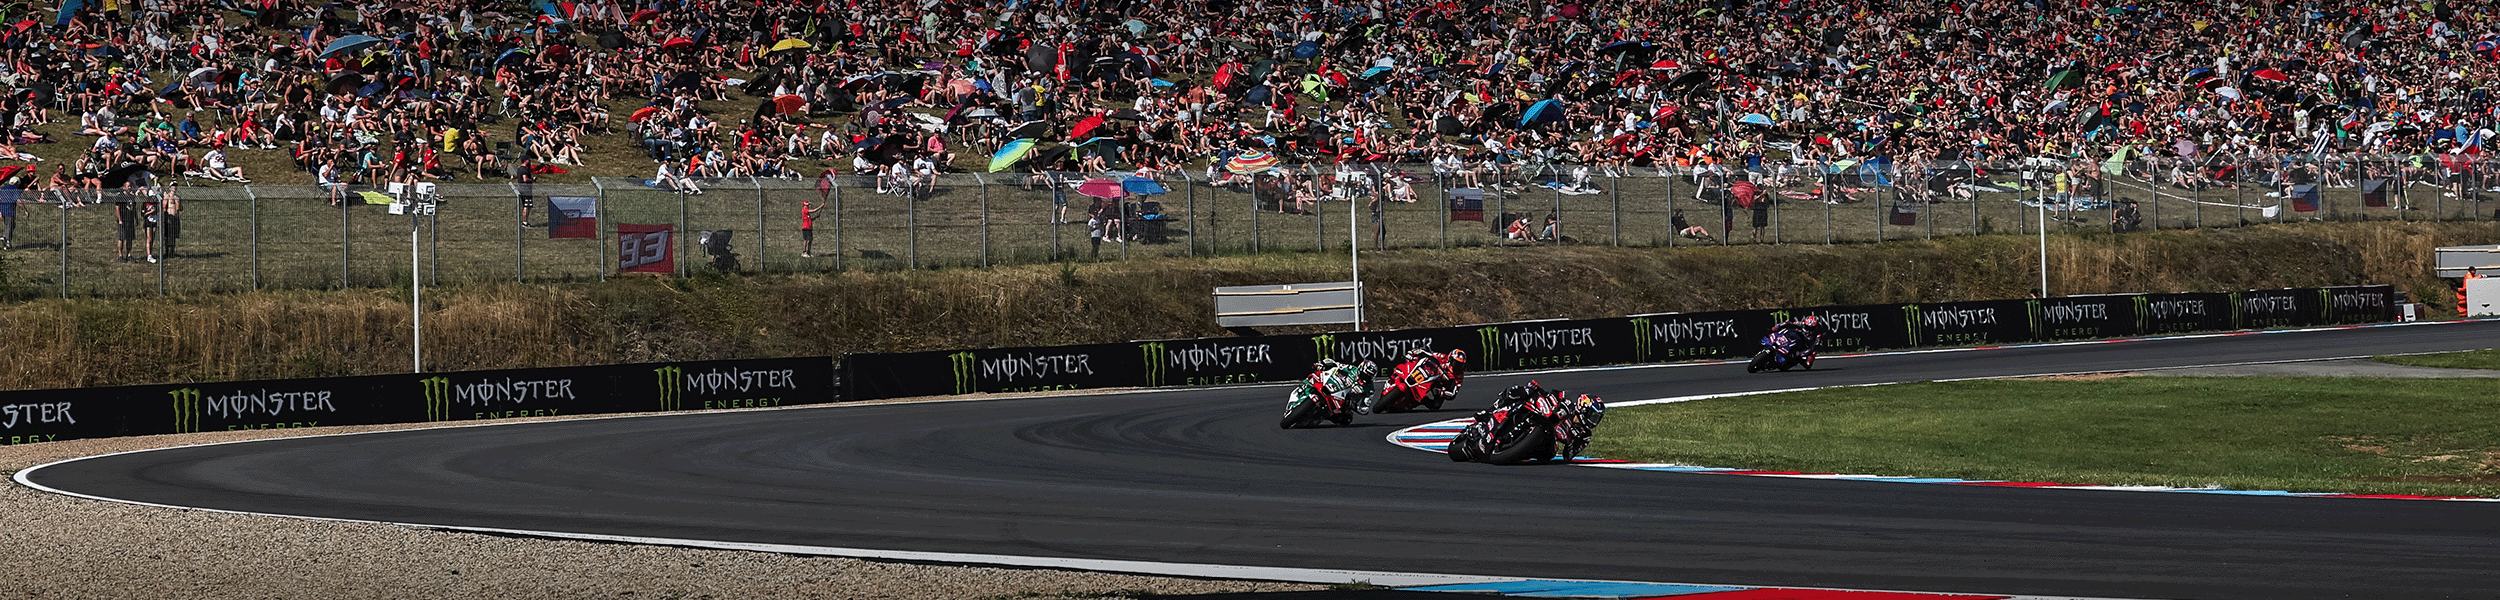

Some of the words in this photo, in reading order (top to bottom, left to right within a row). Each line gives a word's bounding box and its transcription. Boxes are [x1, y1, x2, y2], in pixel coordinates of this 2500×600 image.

[620, 229, 669, 269] 93
[2150, 296, 2207, 319] MONSTER
[2243, 292, 2297, 314] MONSTER
[2333, 290, 2385, 311] MONSTER
[1794, 310, 1872, 333] NSTER
[1923, 305, 1997, 330] MONSTER
[2043, 301, 2108, 324] MONSTER
[1504, 326, 1596, 353] MONSTER
[1653, 317, 1739, 344] MONSTER
[1937, 332, 1988, 342] ENERGY
[2055, 327, 2099, 337] ENERGY
[1169, 342, 1273, 371] MONSTER
[1519, 354, 1582, 367] ENERGY
[1668, 346, 1726, 357] ENERGY
[981, 351, 1095, 382] MONSTER
[1411, 369, 1425, 384] 10
[686, 366, 797, 395] MONSTER
[1186, 373, 1259, 386] ENERGY
[455, 376, 576, 407] MONSTER
[2, 401, 76, 429] STER
[207, 388, 336, 419] MONSTER
[475, 408, 559, 420] ENERGY
[704, 397, 781, 410] ENERGY
